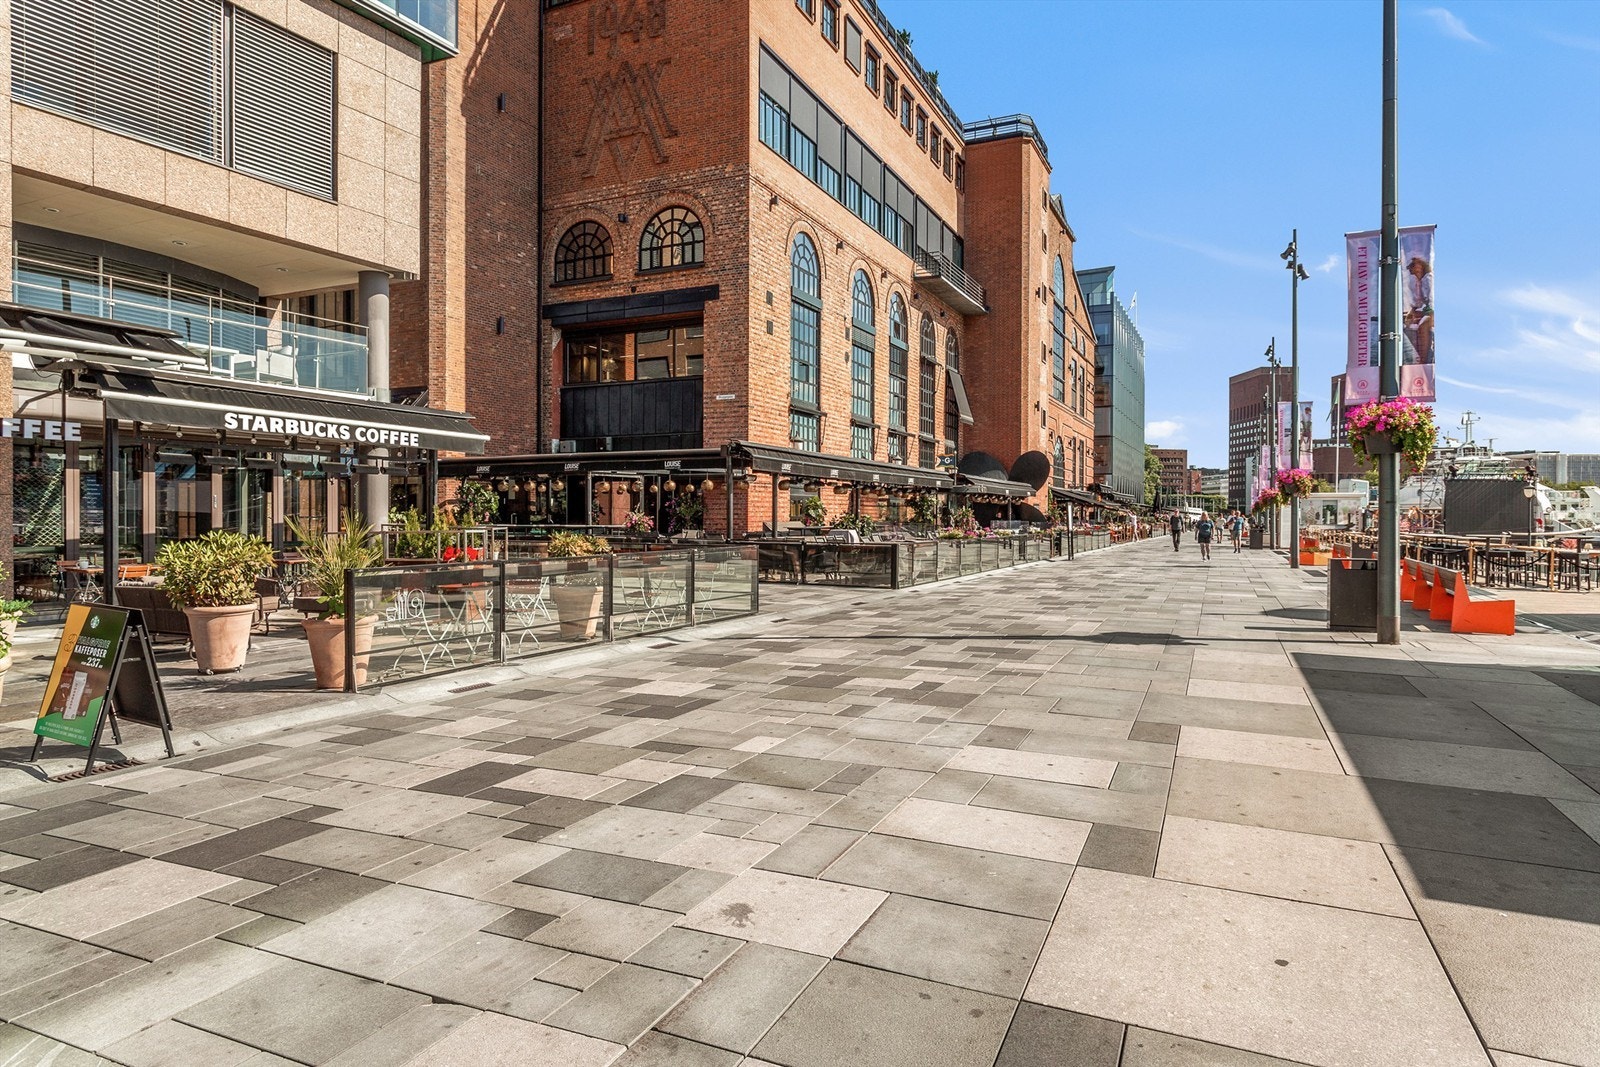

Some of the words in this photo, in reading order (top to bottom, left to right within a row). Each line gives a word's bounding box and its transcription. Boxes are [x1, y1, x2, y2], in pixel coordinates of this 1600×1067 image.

[1358, 246, 1368, 259] ET
[1358, 261, 1368, 280] HAV
[1358, 281, 1368, 295] AV
[1357, 296, 1368, 367] MULIGHETER
[2, 417, 82, 442] FFEE
[224, 412, 351, 440] STARBUCKS
[355, 426, 420, 447] COFFEE
[564, 462, 580, 470] LOUISE
[74, 644, 108, 658] KAFFEPOSER
[86, 657, 101, 668] 237
